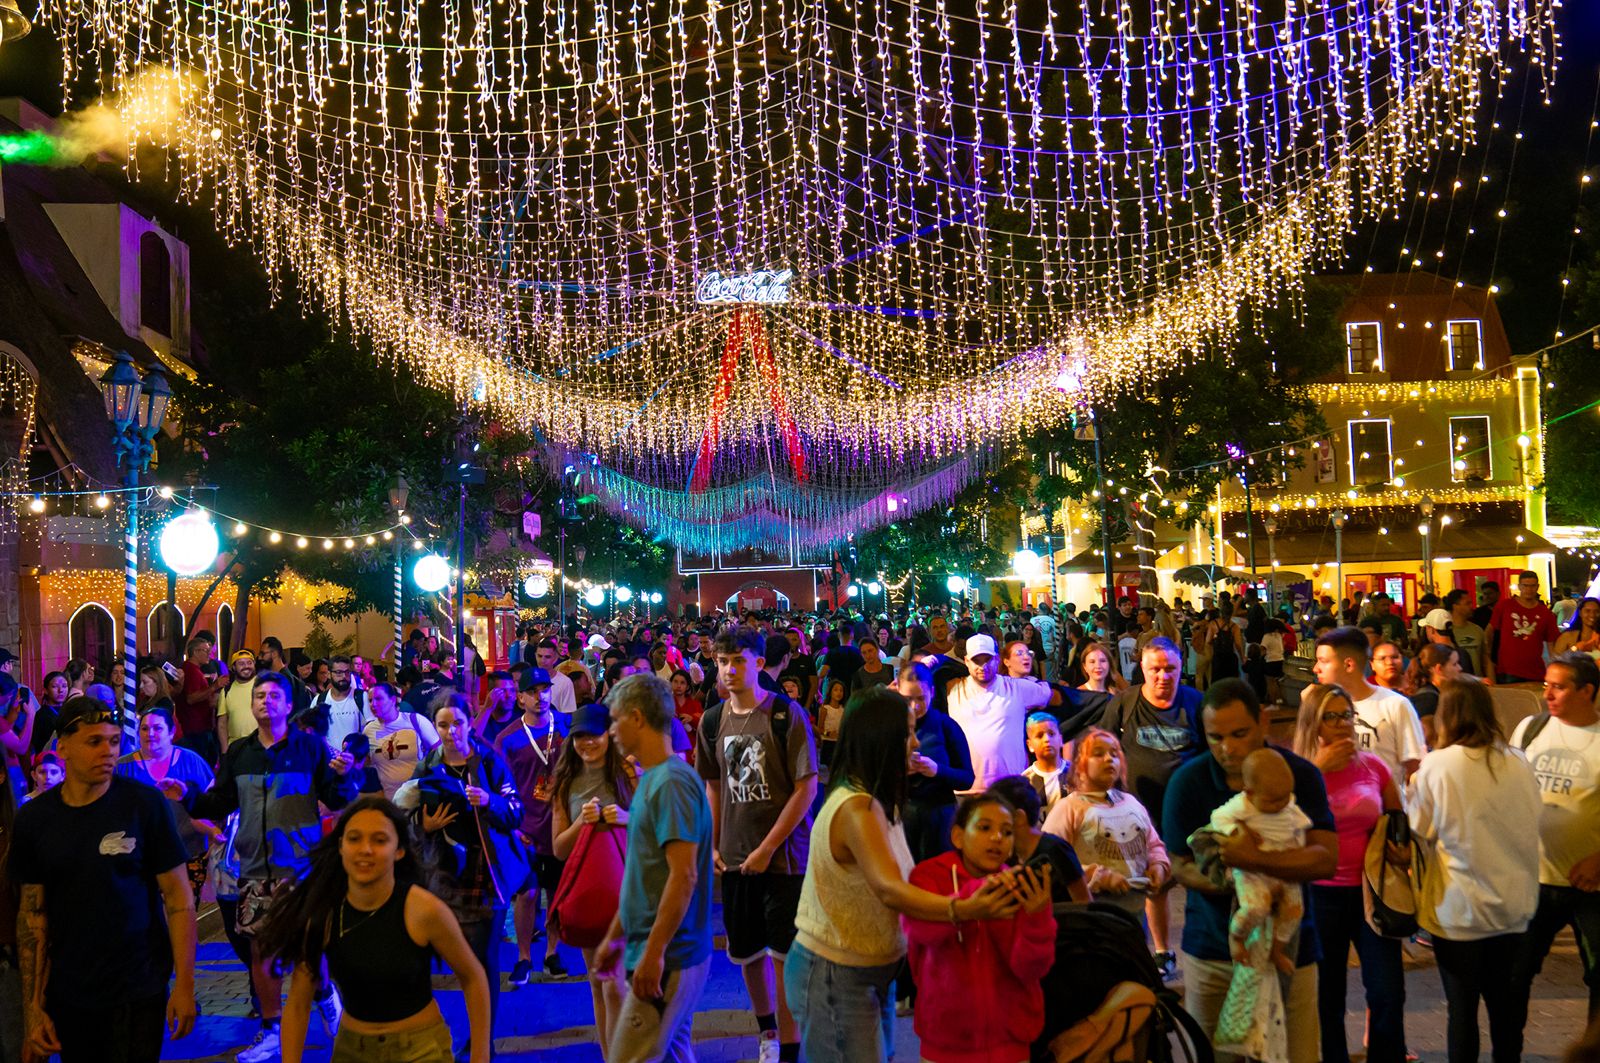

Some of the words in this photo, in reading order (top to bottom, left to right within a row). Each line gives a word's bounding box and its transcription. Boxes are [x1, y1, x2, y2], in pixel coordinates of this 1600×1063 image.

[698, 270, 792, 302] Coca-Cola
[1535, 755, 1581, 776] GANG
[728, 783, 771, 804] NIKE
[1536, 774, 1572, 796] STER
